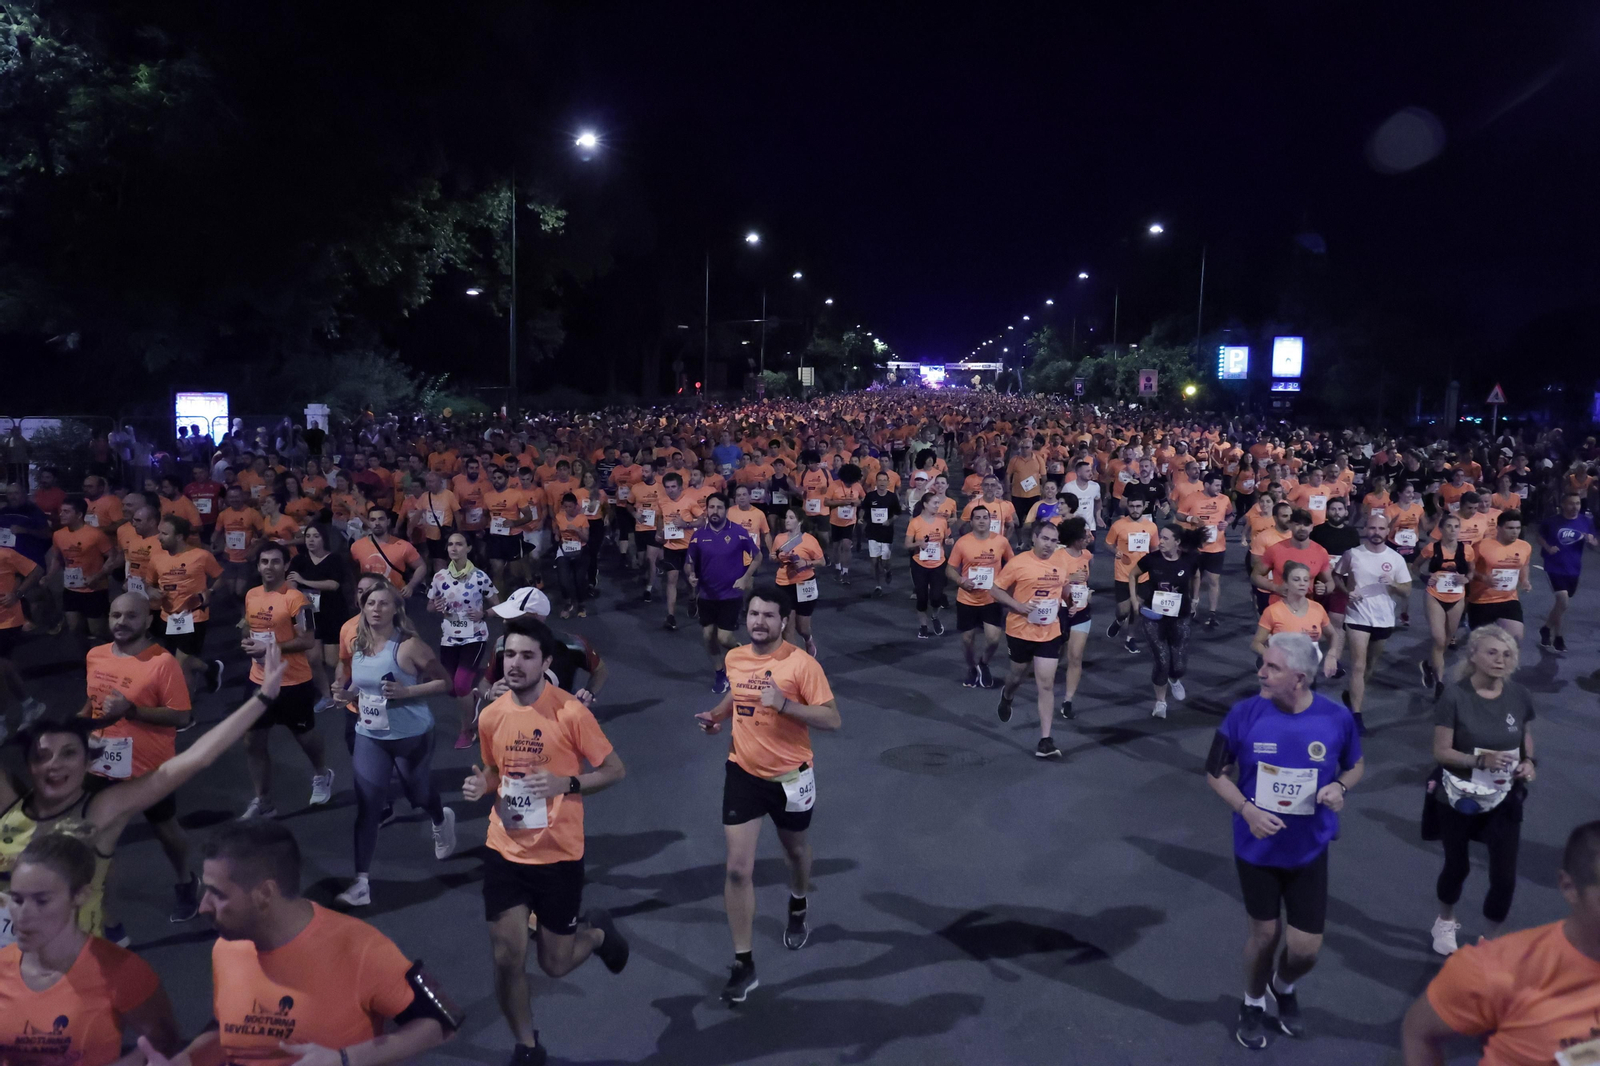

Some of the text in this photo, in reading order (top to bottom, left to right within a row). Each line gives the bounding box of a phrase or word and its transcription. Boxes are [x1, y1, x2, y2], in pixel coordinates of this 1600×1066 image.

[1160, 599, 1175, 607] 6170
[1272, 782, 1302, 796] 6737
[506, 796, 532, 808] 9424
[244, 1014, 296, 1027] NOCTURNA
[224, 1023, 266, 1036] SEVILLA
